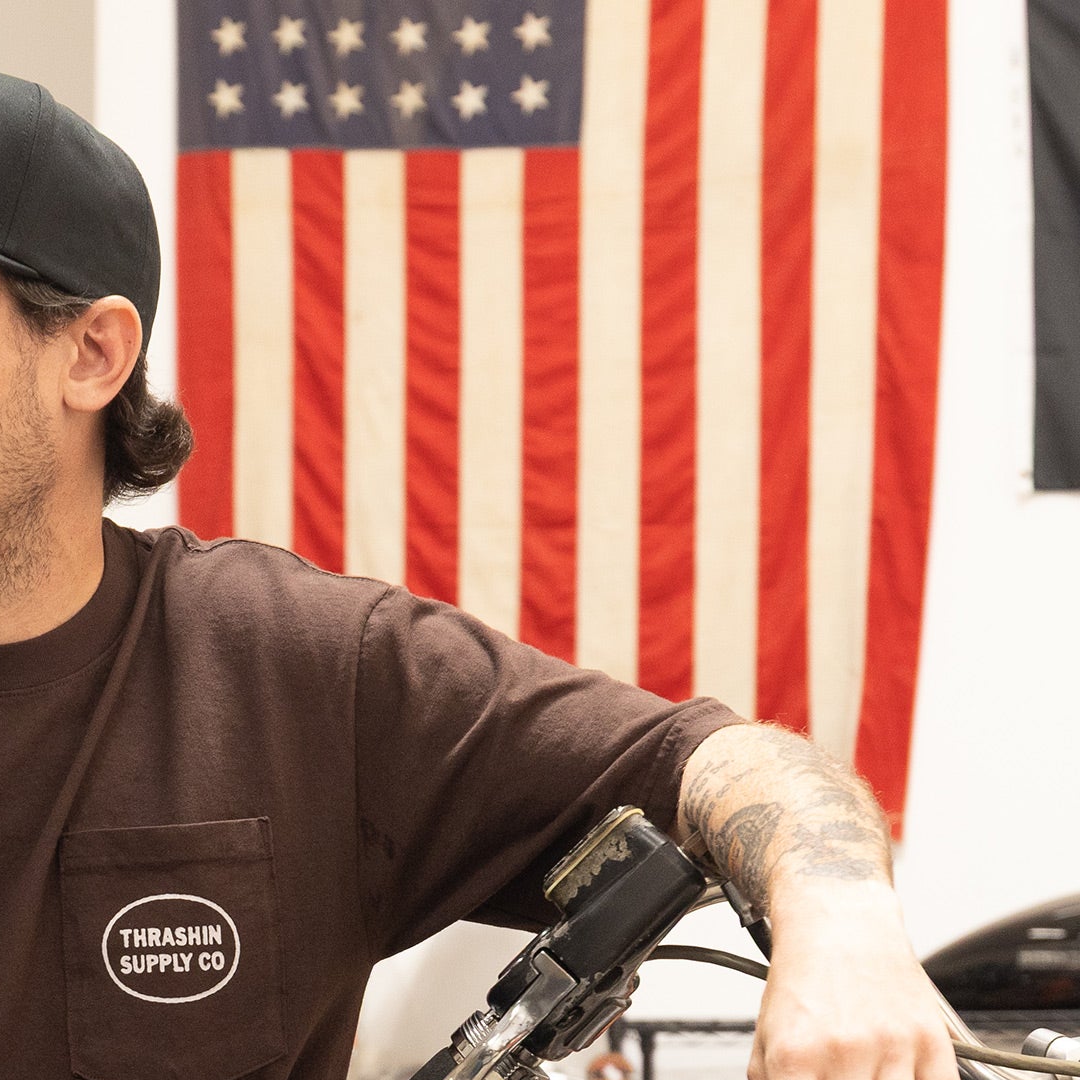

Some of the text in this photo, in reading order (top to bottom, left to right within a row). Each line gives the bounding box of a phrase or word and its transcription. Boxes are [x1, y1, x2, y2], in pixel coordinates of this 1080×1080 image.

[119, 924, 223, 949] THRASHIN
[120, 951, 226, 975] SUPPLY CO
